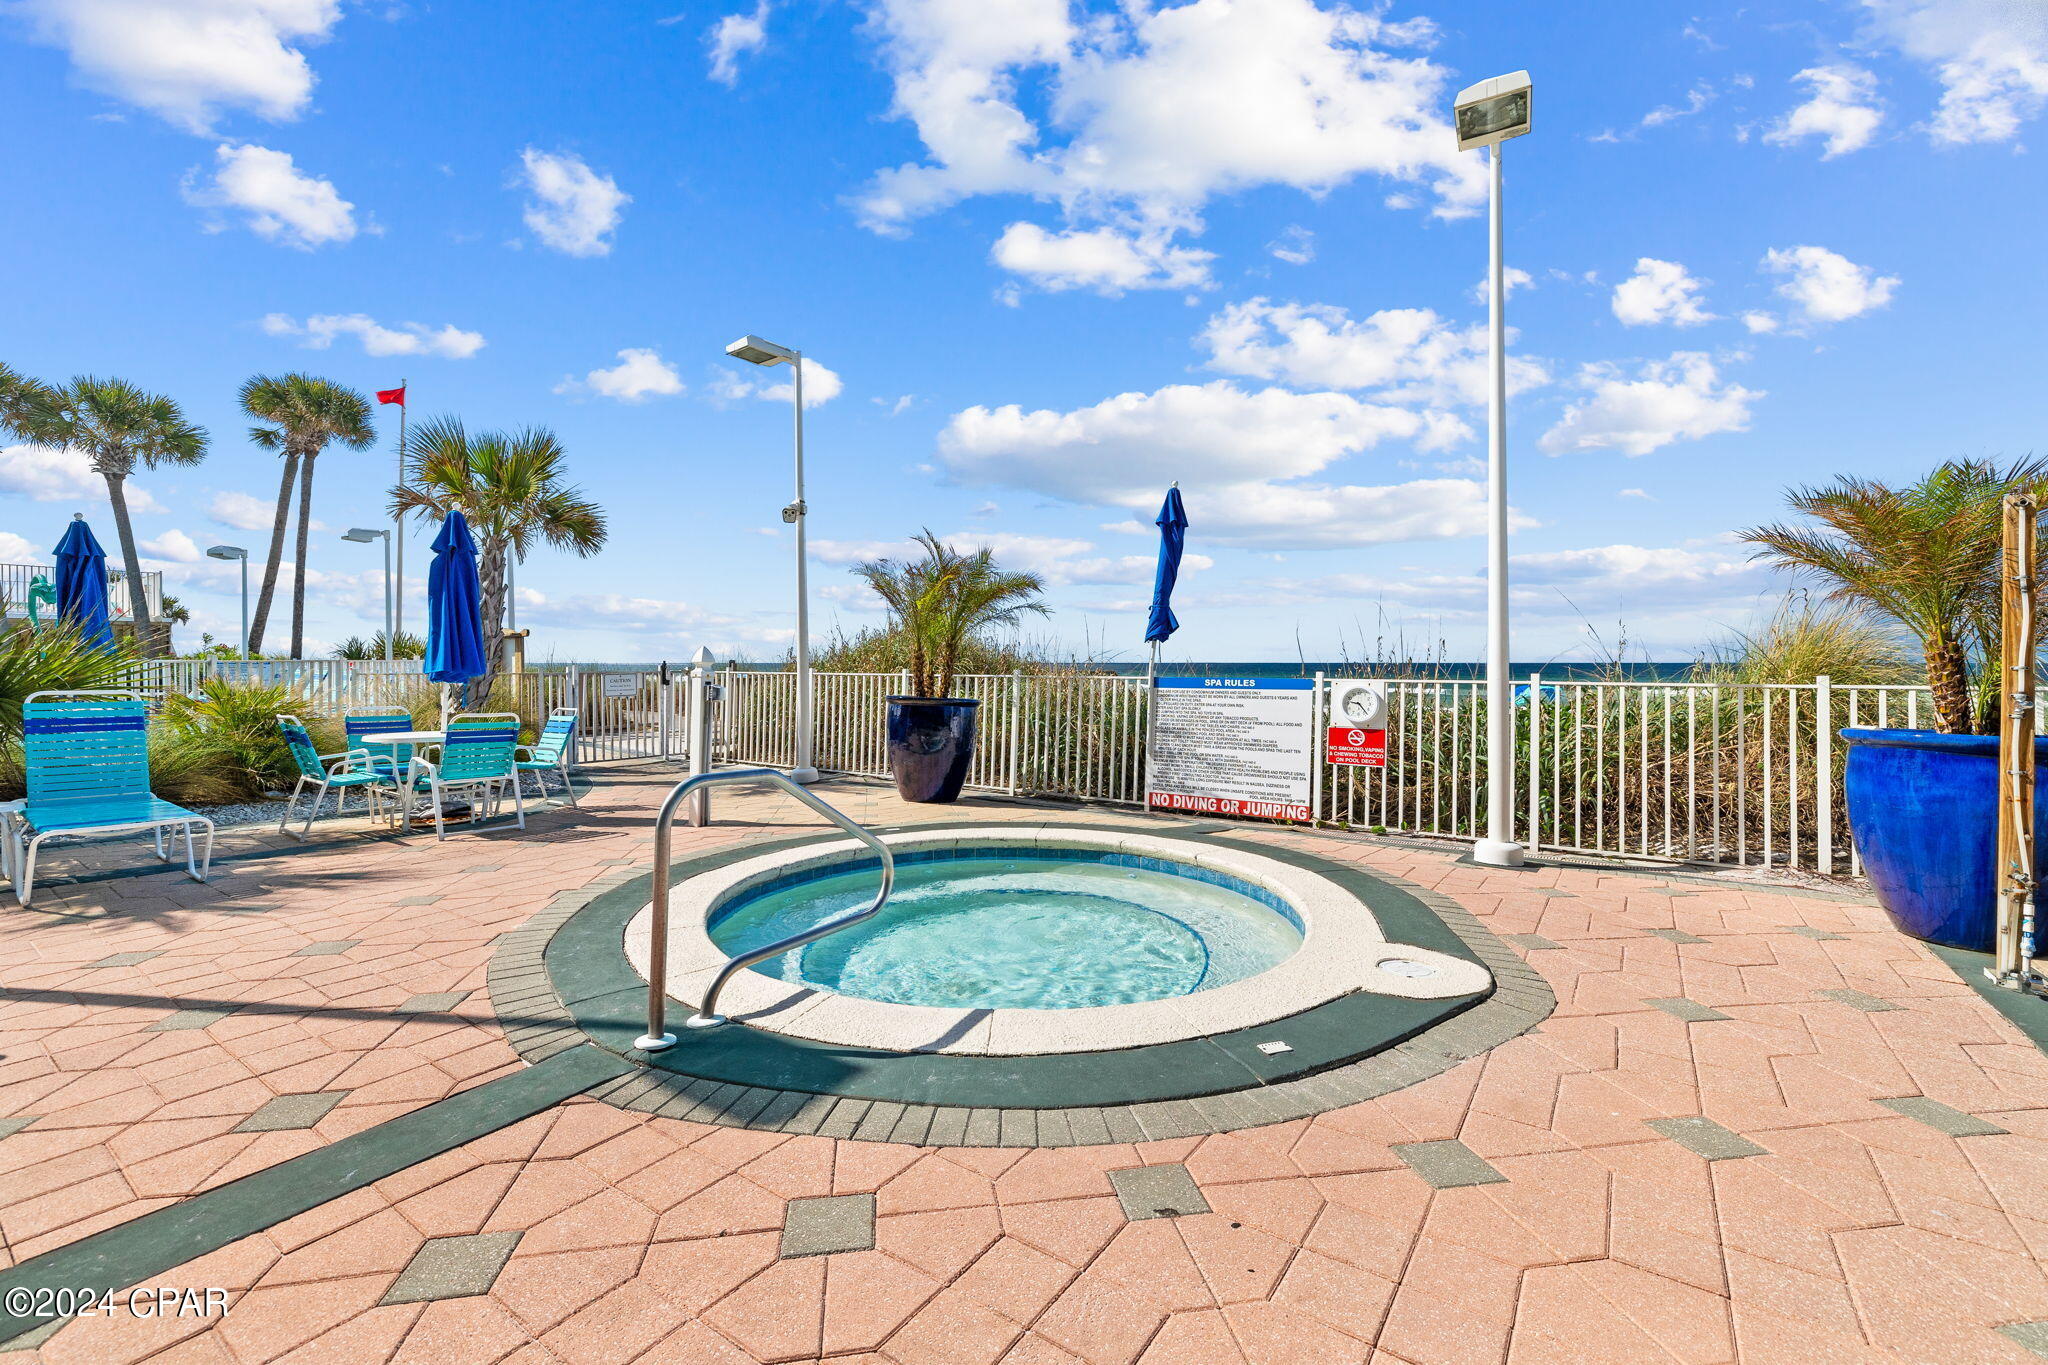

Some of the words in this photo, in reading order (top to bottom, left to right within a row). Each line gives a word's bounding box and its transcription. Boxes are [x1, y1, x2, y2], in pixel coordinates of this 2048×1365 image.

[1152, 794, 1169, 806] NO
[1174, 795, 1216, 811] DIVING
[1221, 800, 1239, 814] OR
[1243, 802, 1307, 820] JUMPING
